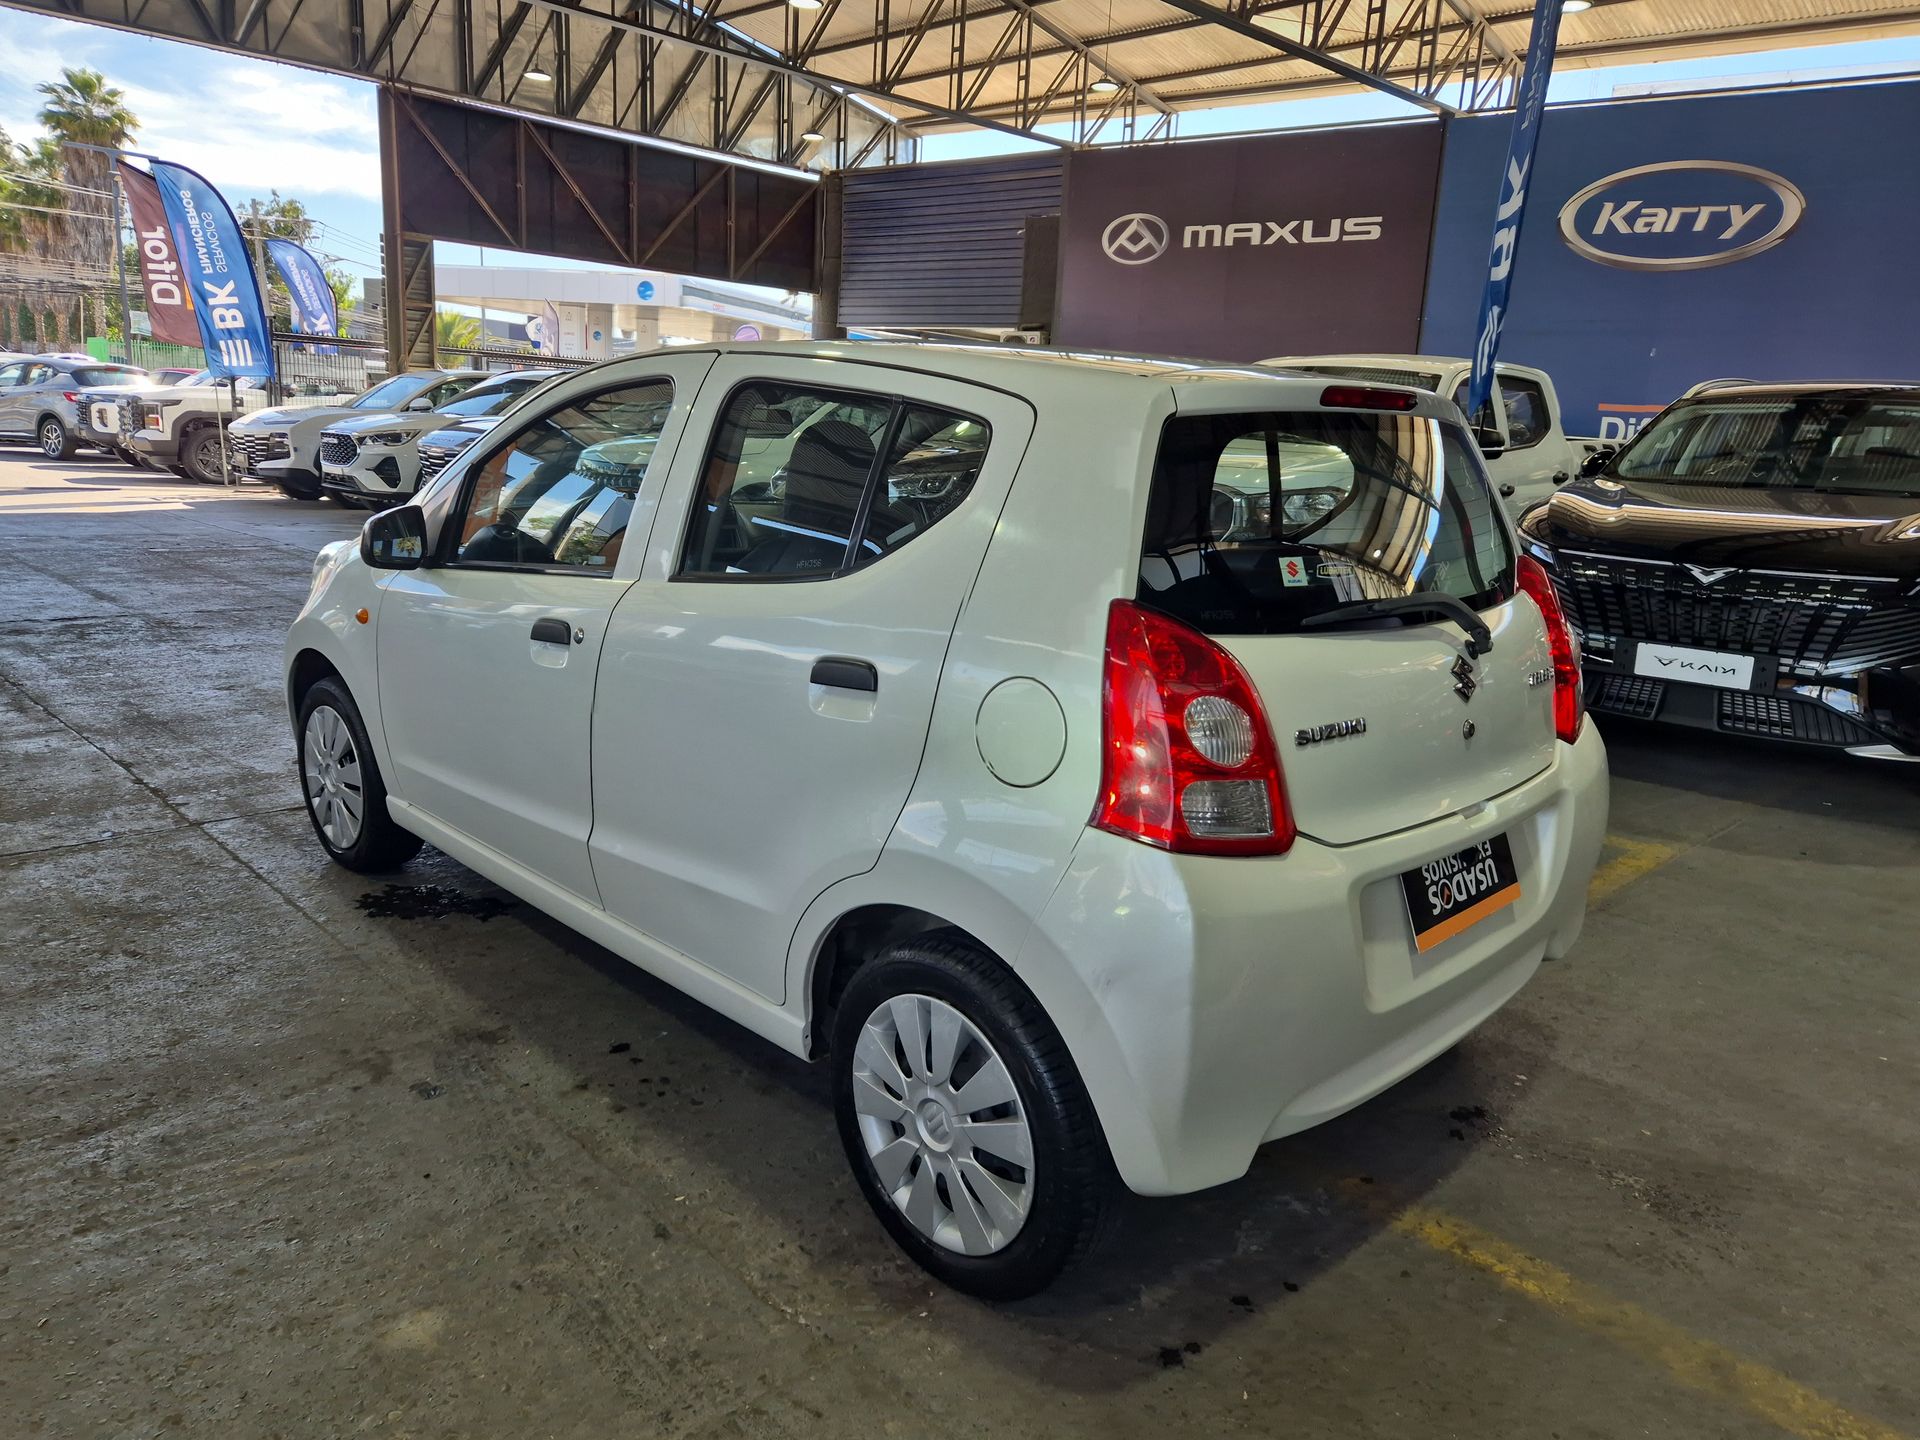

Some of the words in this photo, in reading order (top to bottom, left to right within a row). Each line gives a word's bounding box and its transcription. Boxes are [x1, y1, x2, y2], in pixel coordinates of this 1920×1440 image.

[1182, 215, 1383, 250] MAXUS
[1592, 198, 1768, 240] Karry
[1295, 717, 1366, 746] SUZUKI
[1421, 840, 1492, 886] EXSIVOS
[1427, 858, 1499, 916] USADOS
